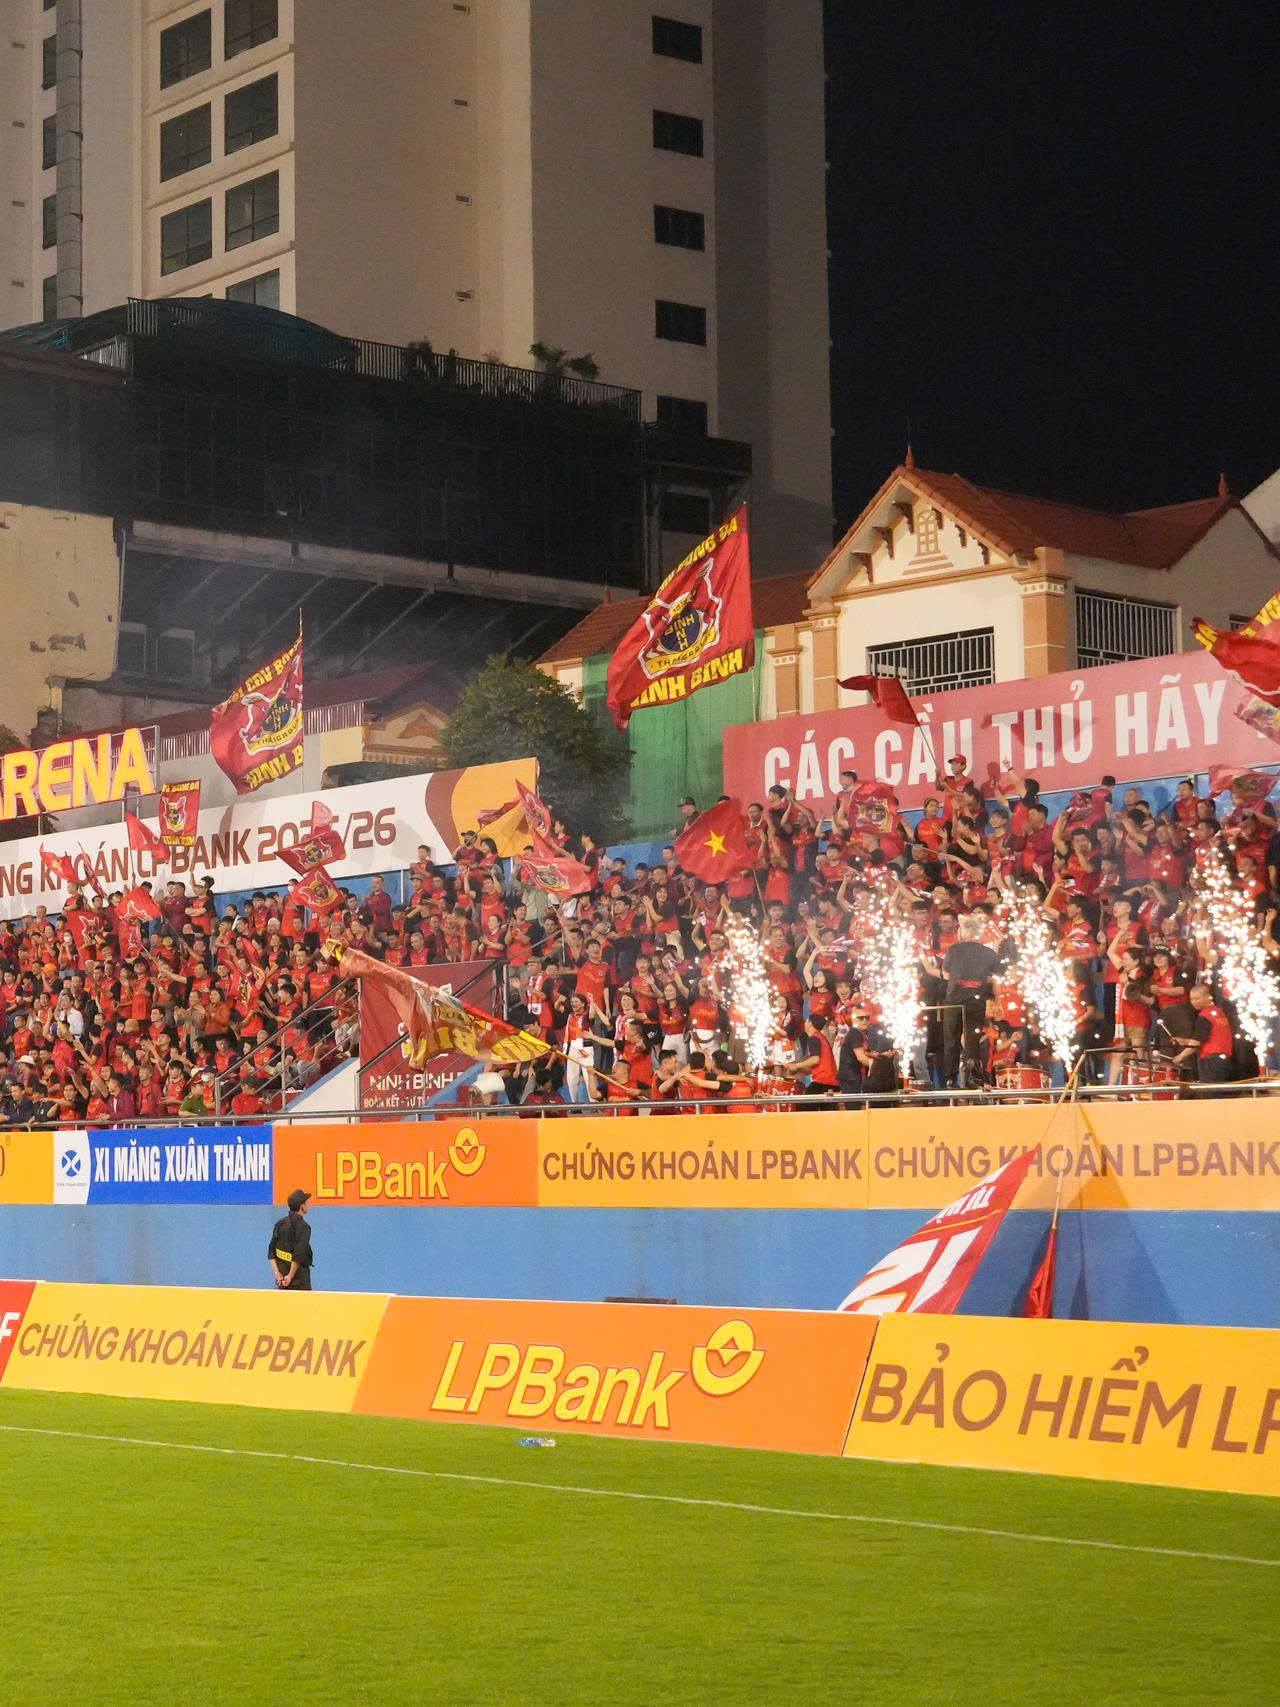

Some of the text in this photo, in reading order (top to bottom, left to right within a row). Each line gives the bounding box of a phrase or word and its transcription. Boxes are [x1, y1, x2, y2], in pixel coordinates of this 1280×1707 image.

[991, 679, 1093, 772] THỦ
[1114, 673, 1227, 757] HÃY
[94, 1135, 270, 1182] XI MĂNG XUÂN THÀNH
[316, 1150, 450, 1200] LPBank
[542, 1139, 862, 1182] CHỨNG KHOÁN LPBANK
[874, 1135, 991, 1179] CHỨNG
[1133, 1141, 1280, 1177] LPBANK
[18, 1313, 367, 1379] CHỨNG KHOÁN LPBANK
[430, 1341, 687, 1430] LPBank
[861, 1343, 1009, 1432] BẢO
[1019, 1345, 1203, 1449] HIỂM
